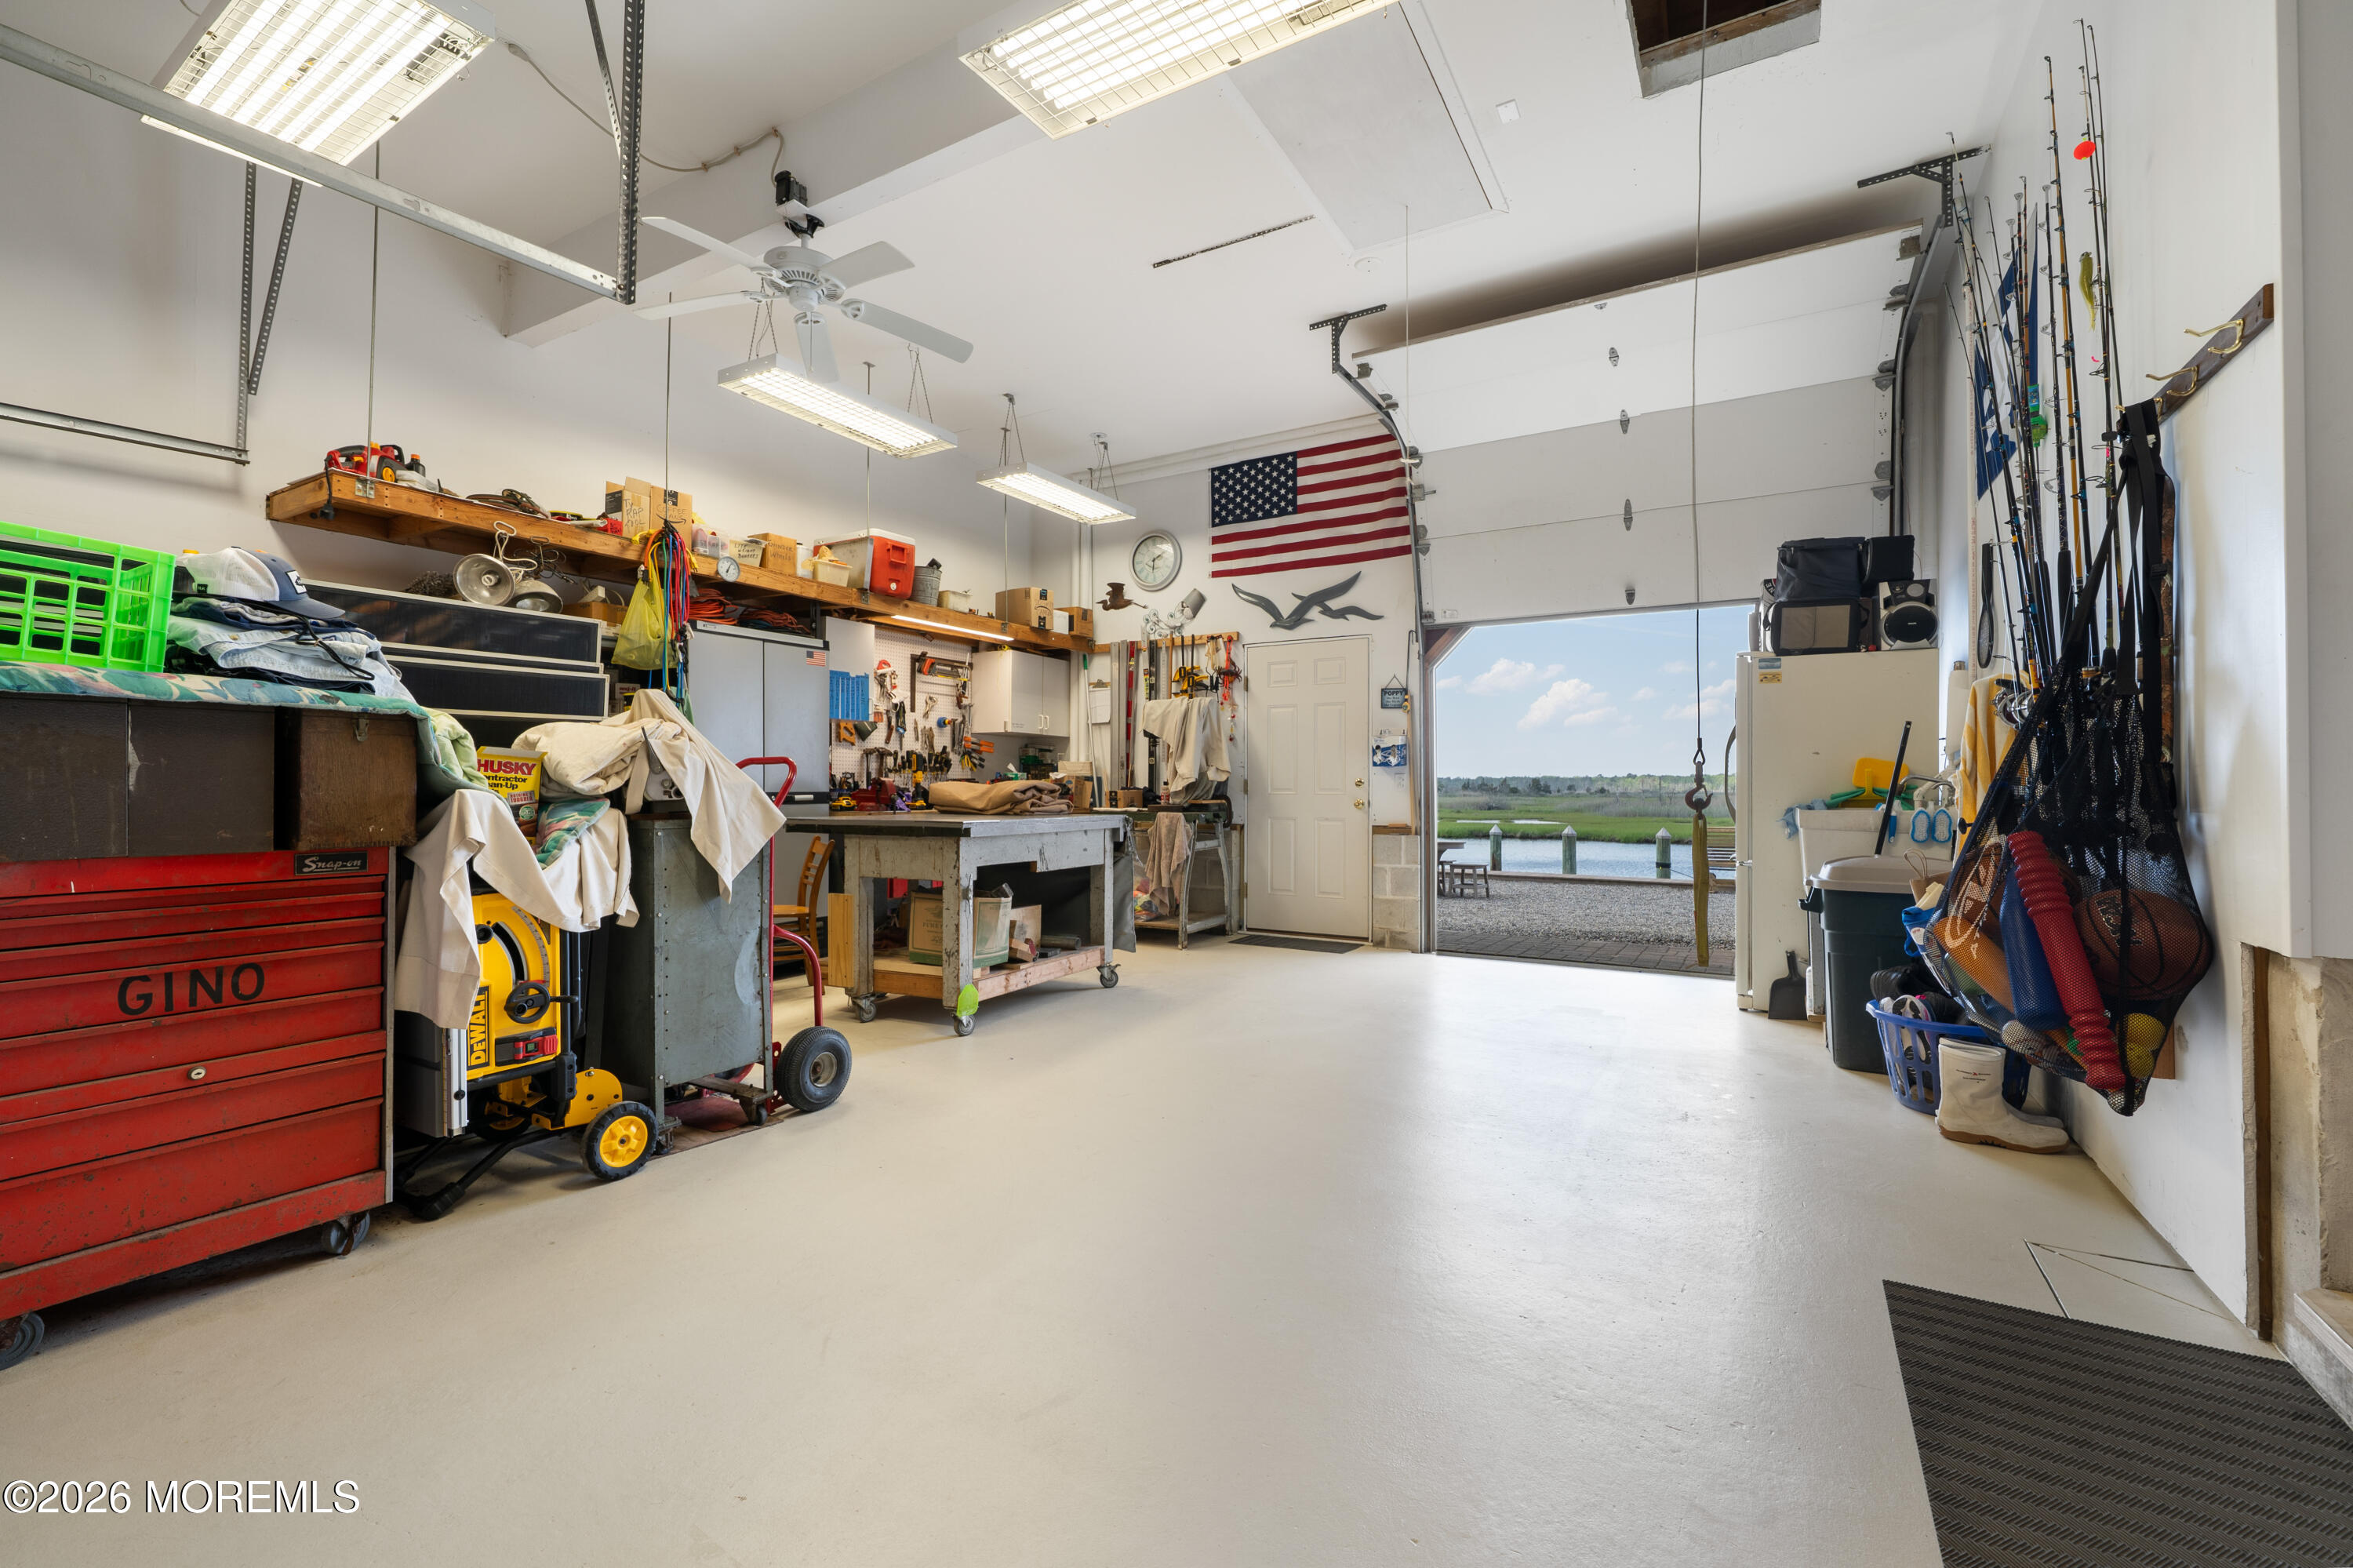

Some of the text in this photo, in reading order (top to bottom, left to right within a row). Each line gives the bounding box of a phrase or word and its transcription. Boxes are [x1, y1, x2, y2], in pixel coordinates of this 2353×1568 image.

[477, 759, 536, 776] HUSKY
[483, 774, 528, 783] ontractor
[302, 856, 362, 872] Snap-on
[118, 962, 265, 1017] GINO
